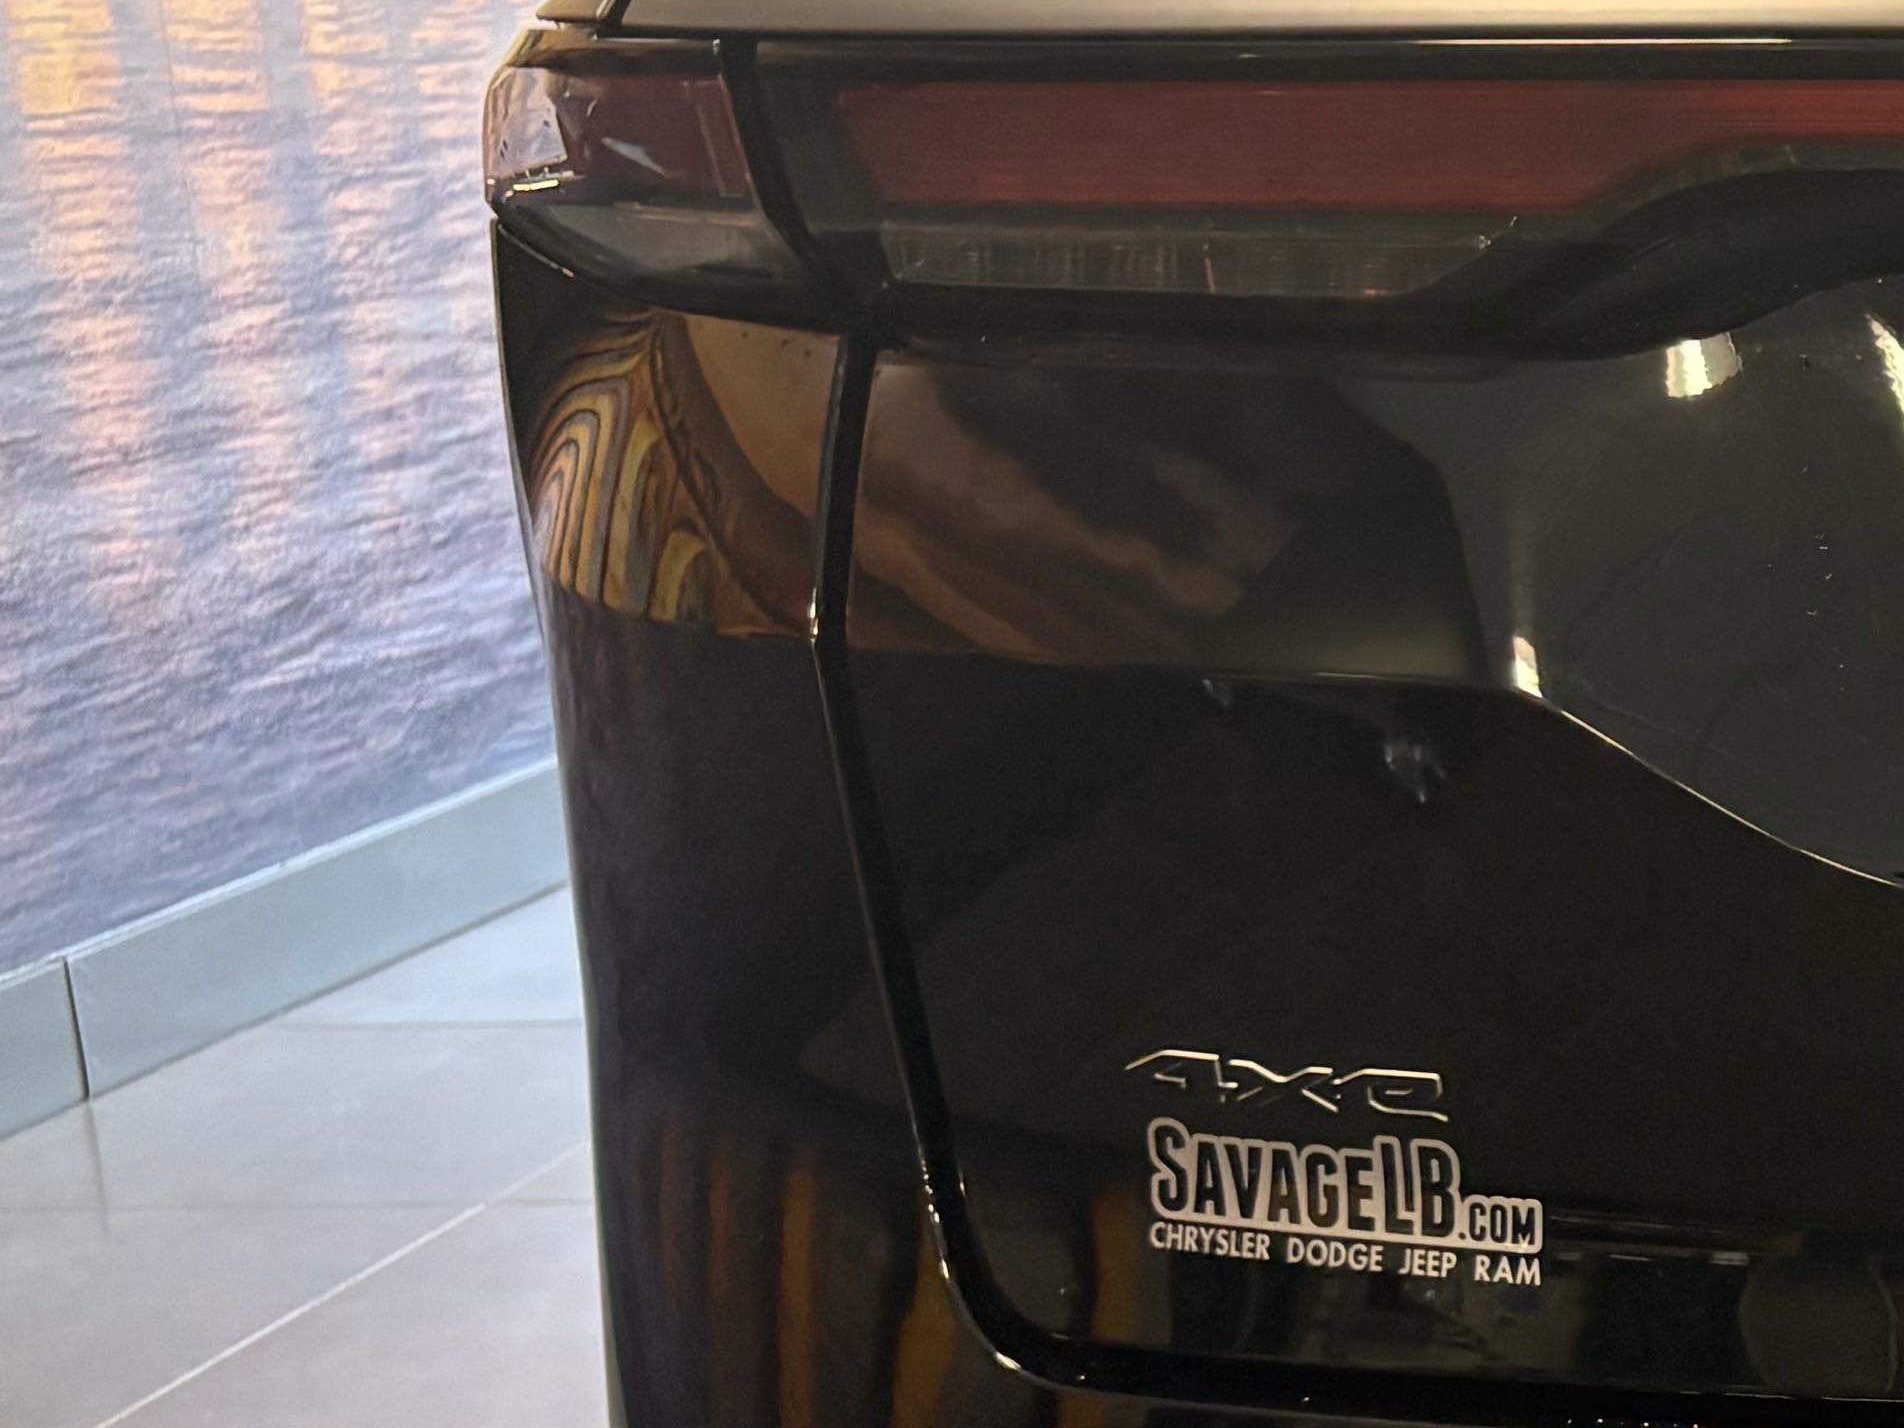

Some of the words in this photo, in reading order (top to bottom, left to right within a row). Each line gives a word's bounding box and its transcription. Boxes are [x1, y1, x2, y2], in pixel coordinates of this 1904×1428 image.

[1149, 1221, 1271, 1262] CHRYSLER
[1286, 1236, 1384, 1273] DODGE
[1397, 1248, 1458, 1279] JEEP
[1474, 1256, 1542, 1286] RAM
